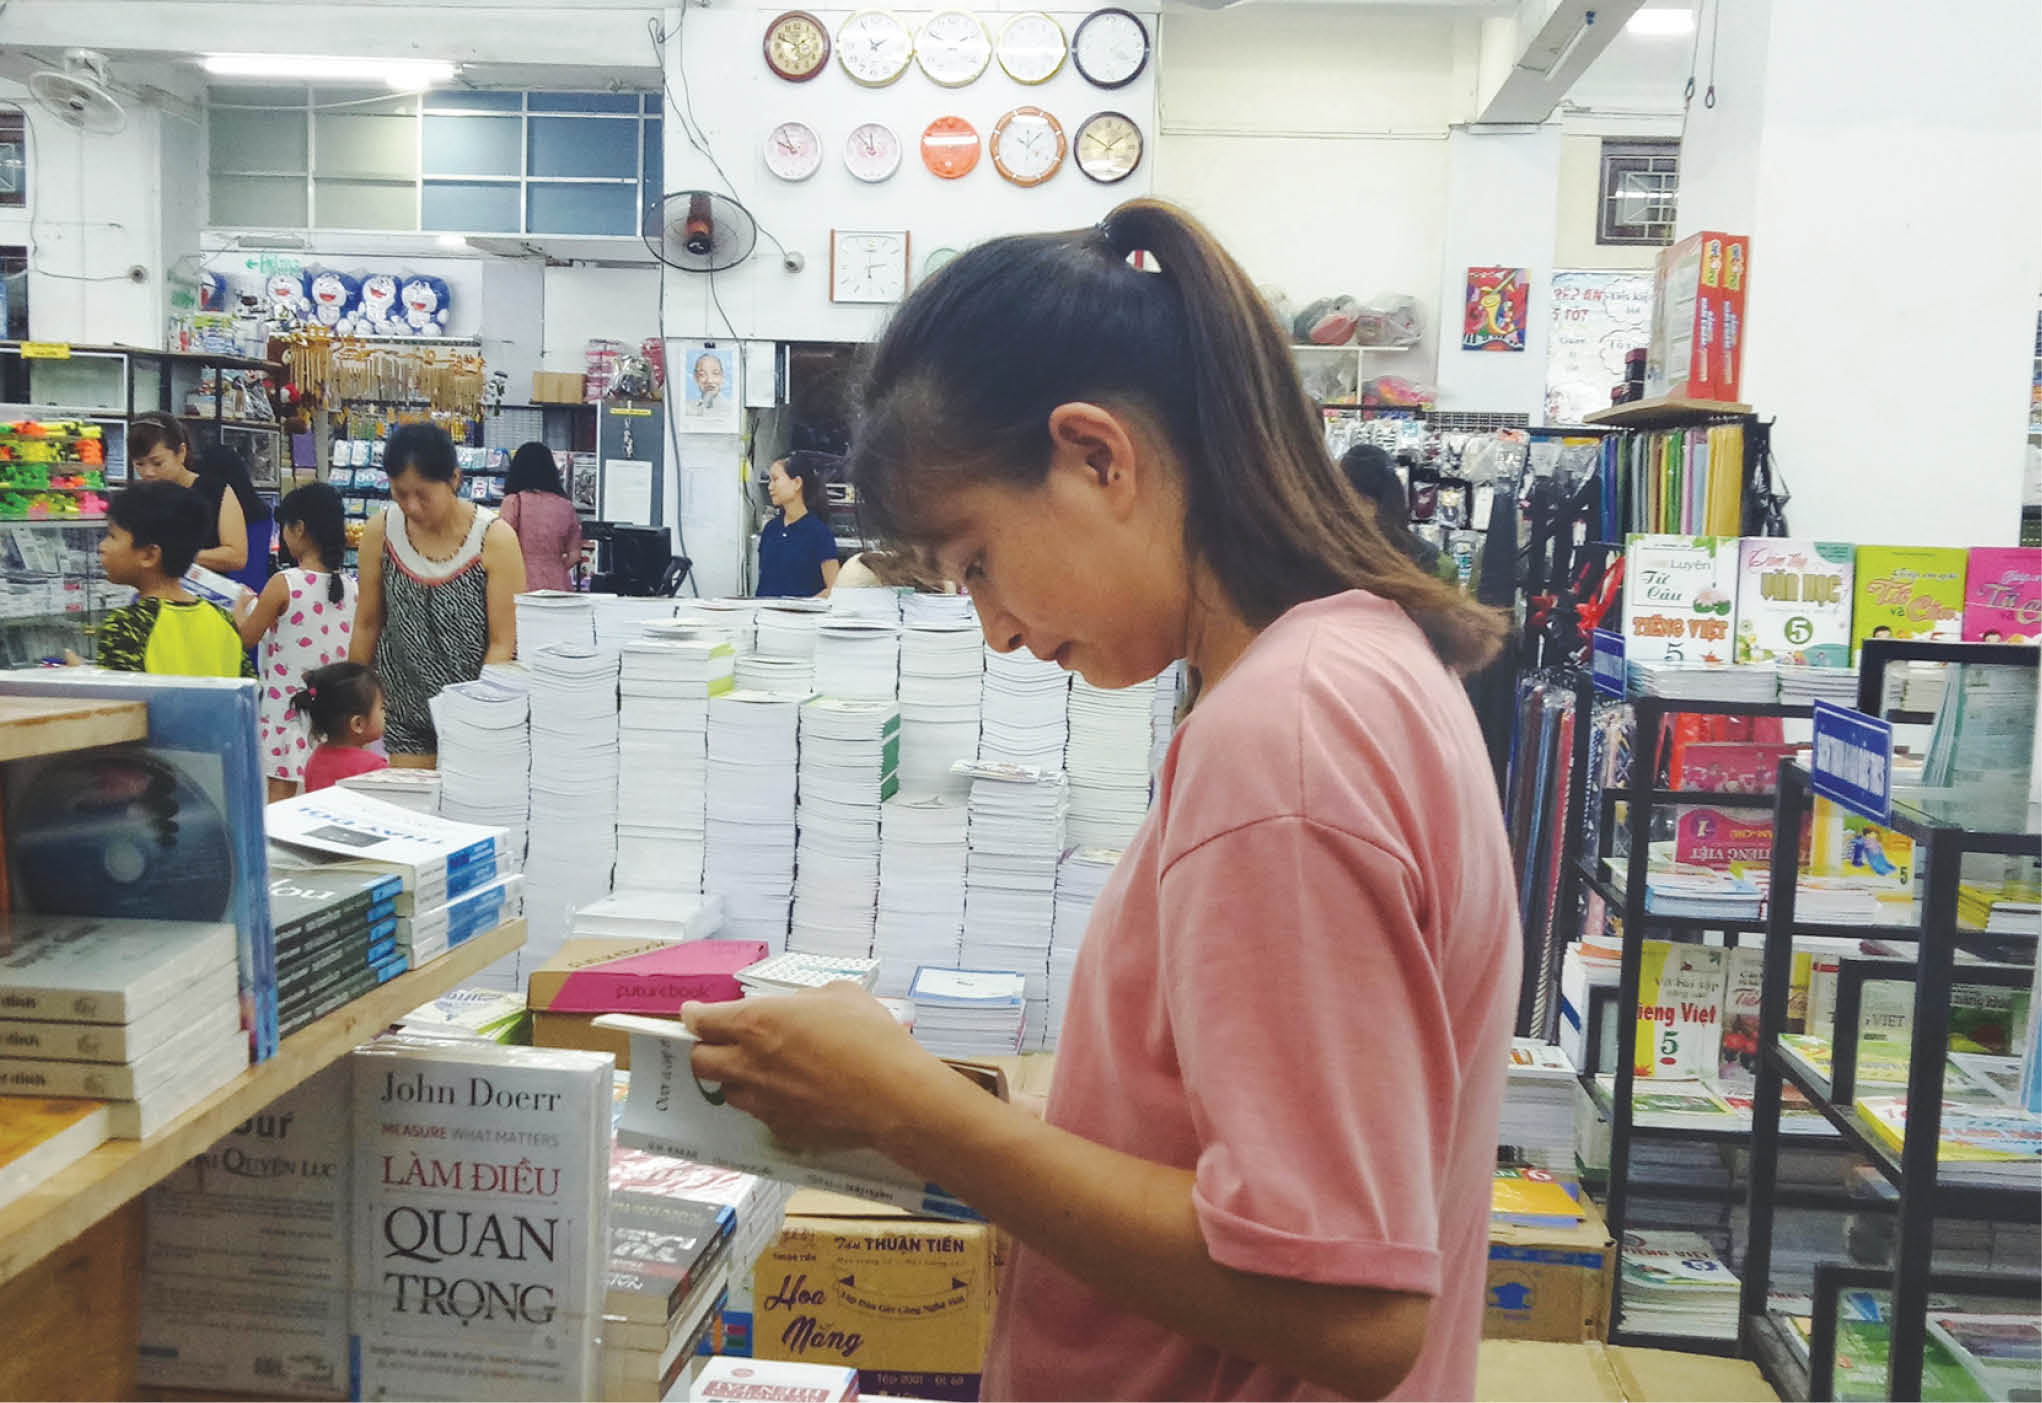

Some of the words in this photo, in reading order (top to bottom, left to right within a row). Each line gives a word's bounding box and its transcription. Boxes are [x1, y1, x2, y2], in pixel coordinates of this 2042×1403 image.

[1632, 614, 1685, 638] TIẾNG
[1688, 617, 1729, 641] VIỆT
[1790, 619, 1807, 642] 5
[1899, 866, 1908, 885] 5
[1660, 1030, 1679, 1056] 5
[380, 1071, 455, 1105] John
[468, 1077, 561, 1112] Doerr
[380, 1121, 448, 1140] MEASURE
[451, 1127, 492, 1144] WHAT
[495, 1129, 561, 1147] MATTERS
[381, 1151, 463, 1190] LÀM
[470, 1156, 561, 1197] ĐIỀU
[383, 1206, 559, 1264] QUAN
[864, 1234, 921, 1255] THUẬN
[926, 1234, 965, 1252] TIẾN
[383, 1272, 557, 1327] TRỌNG
[763, 1273, 826, 1312] Hoa
[781, 1314, 864, 1358] Nắng
